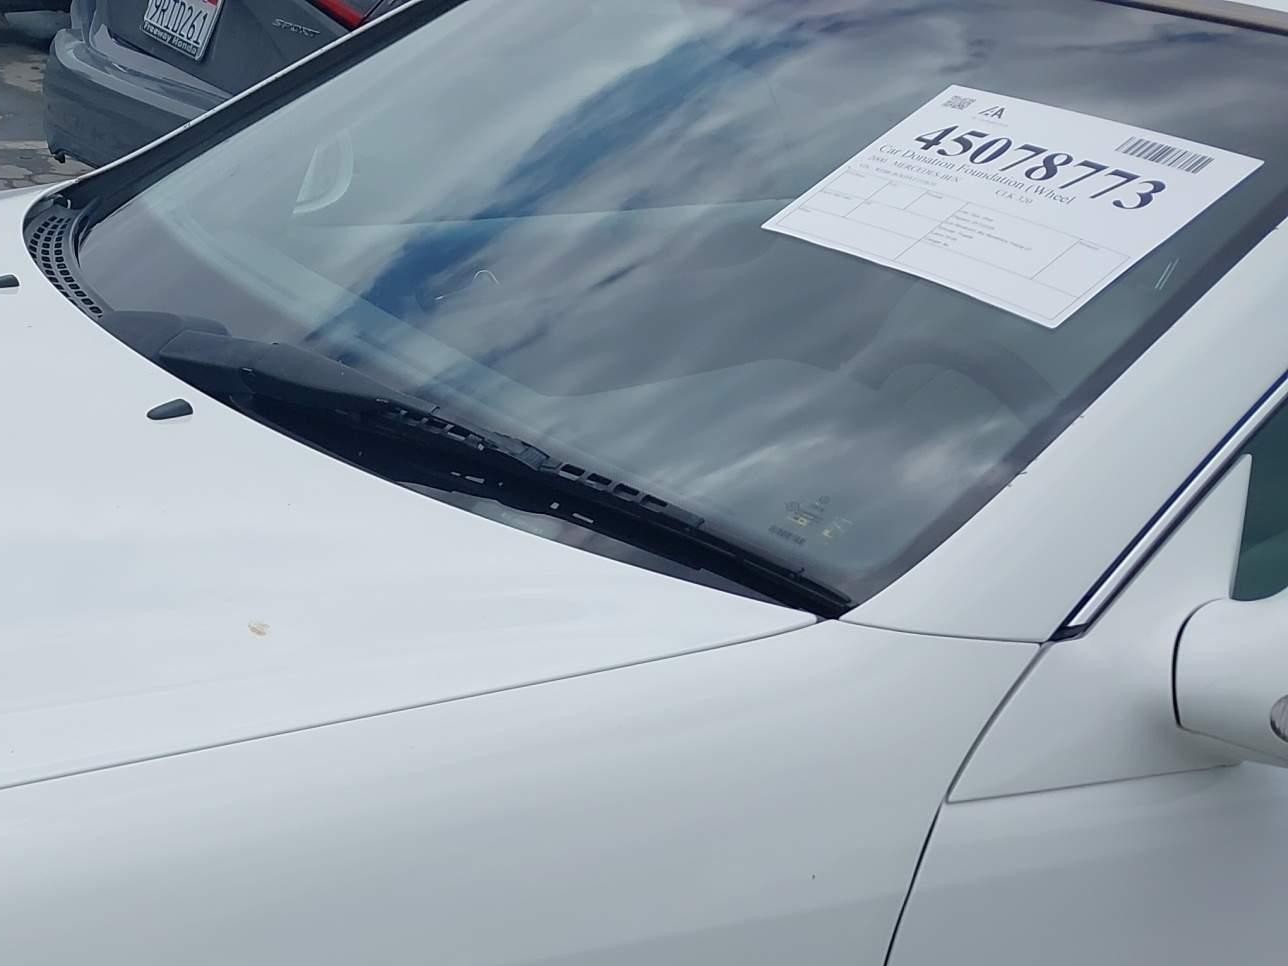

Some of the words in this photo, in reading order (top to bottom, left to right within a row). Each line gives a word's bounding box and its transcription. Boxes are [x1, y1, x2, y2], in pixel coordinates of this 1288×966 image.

[143, 22, 172, 42] Freeway
[172, 37, 197, 54] Honda
[879, 144, 899, 155] Car
[902, 150, 956, 170] Donation
[957, 163, 1025, 188] Foundation
[915, 126, 1167, 210] 45078773
